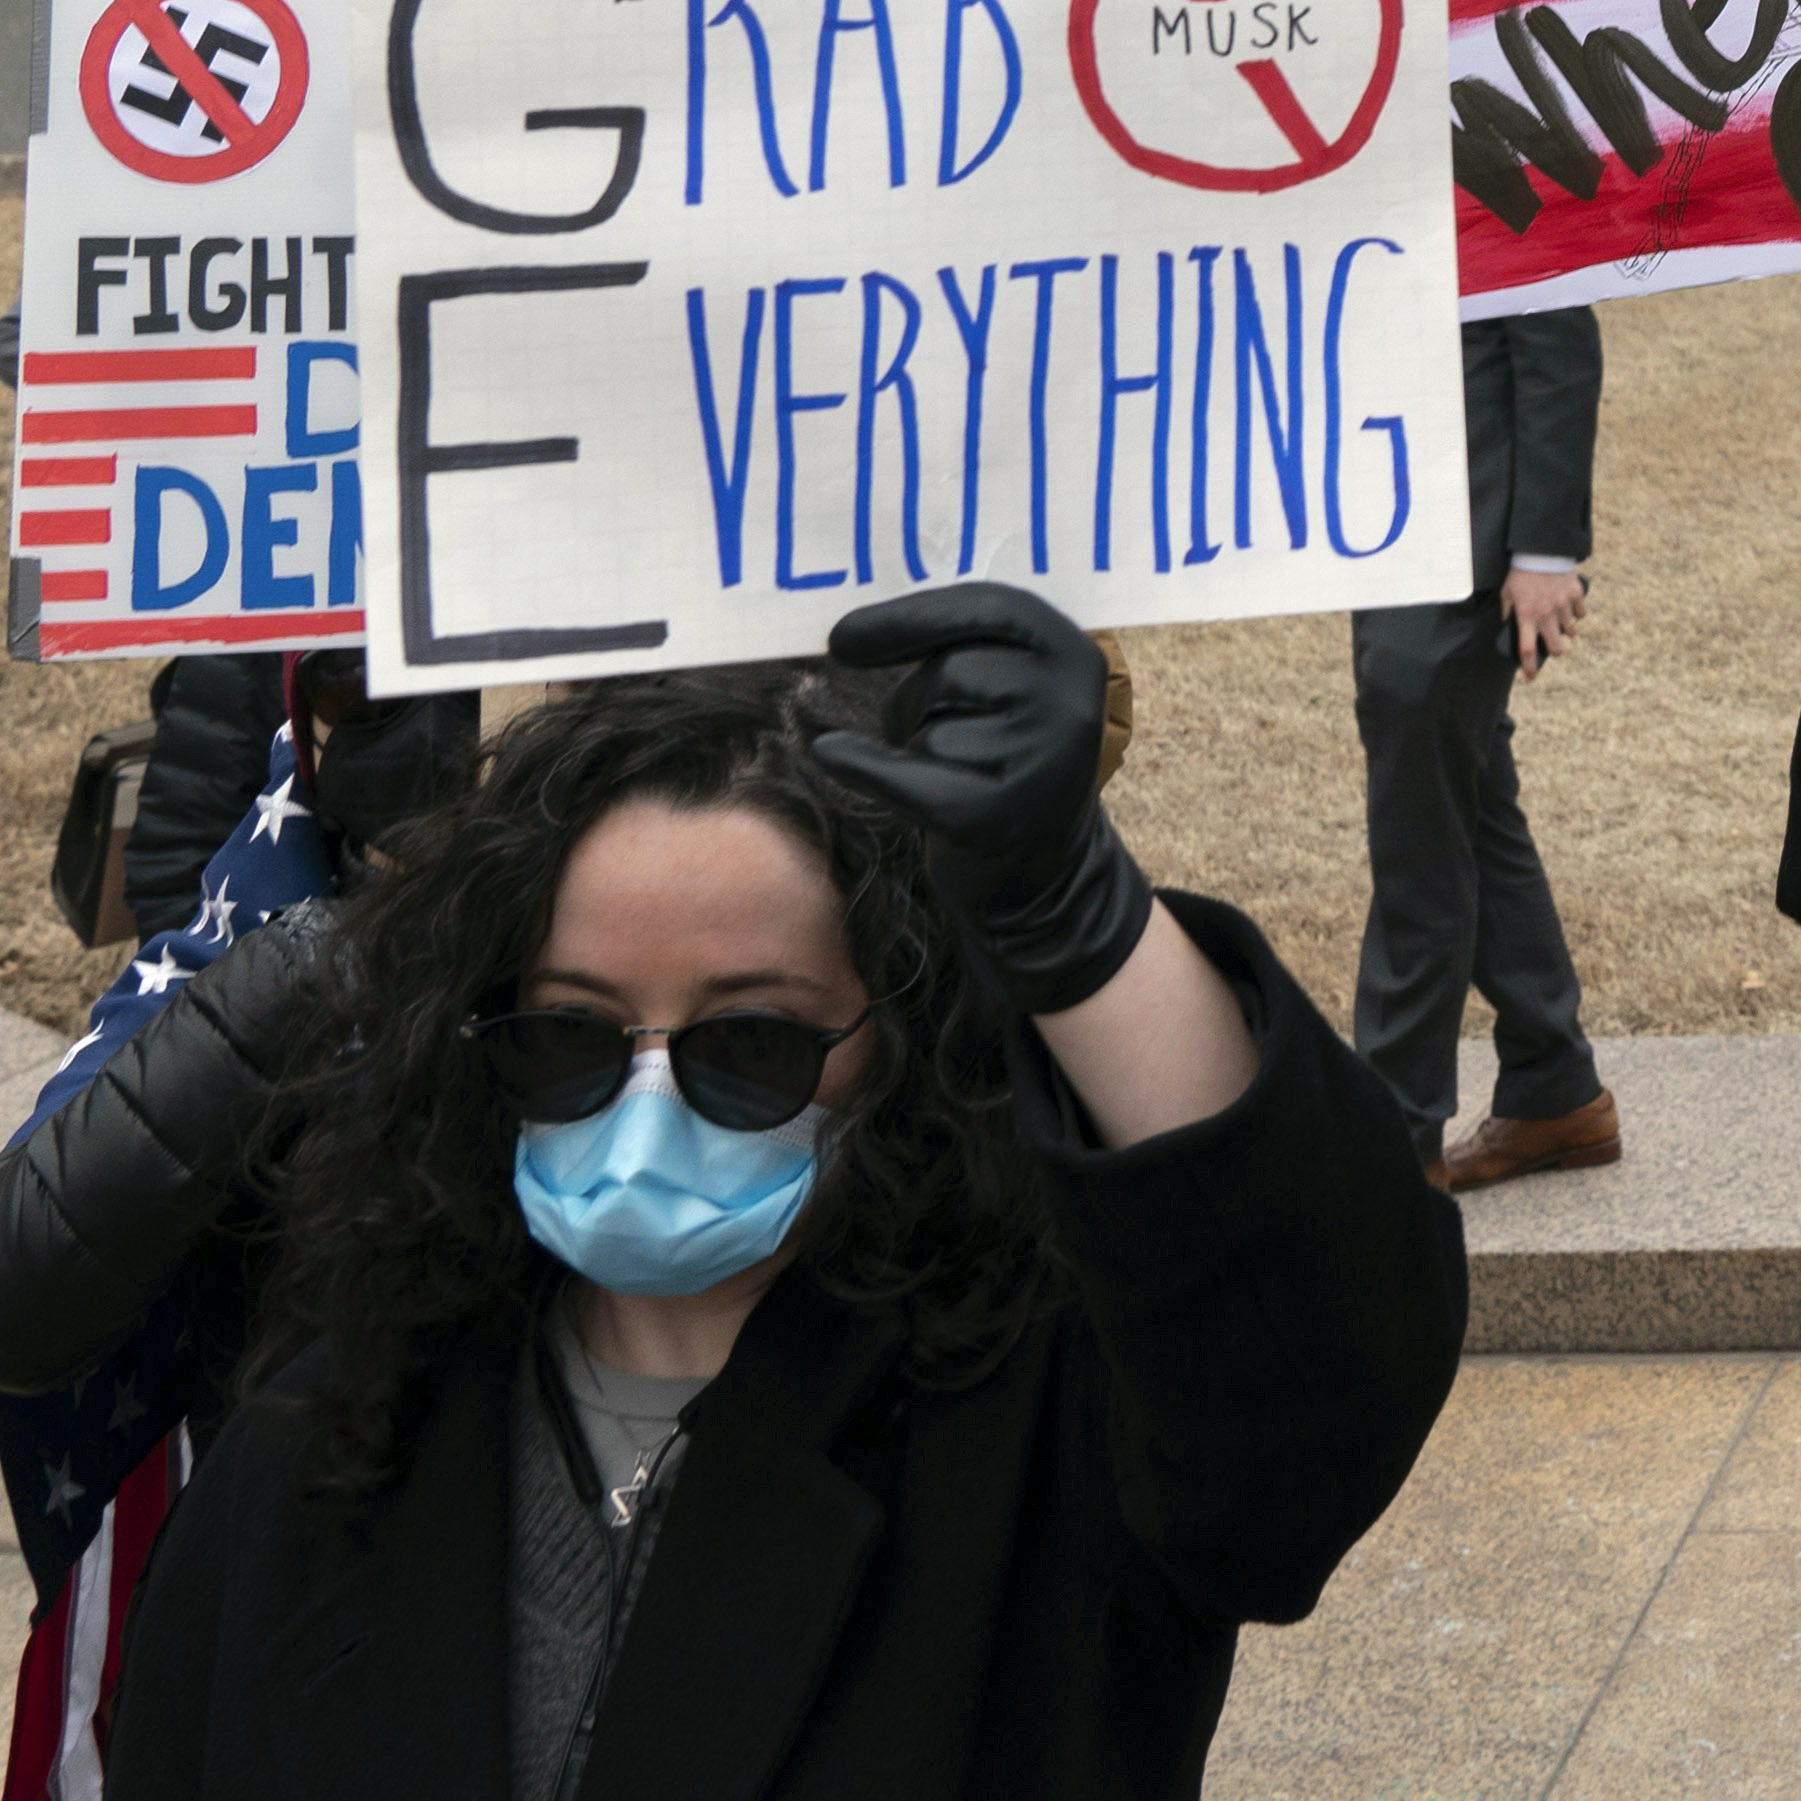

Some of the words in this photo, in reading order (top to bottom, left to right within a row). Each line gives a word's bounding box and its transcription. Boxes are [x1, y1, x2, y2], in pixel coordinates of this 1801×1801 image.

[1152, 2, 1318, 56] MUSK
[76, 236, 356, 336] FIGHT
[401, 237, 1410, 667] EVERYTHING
